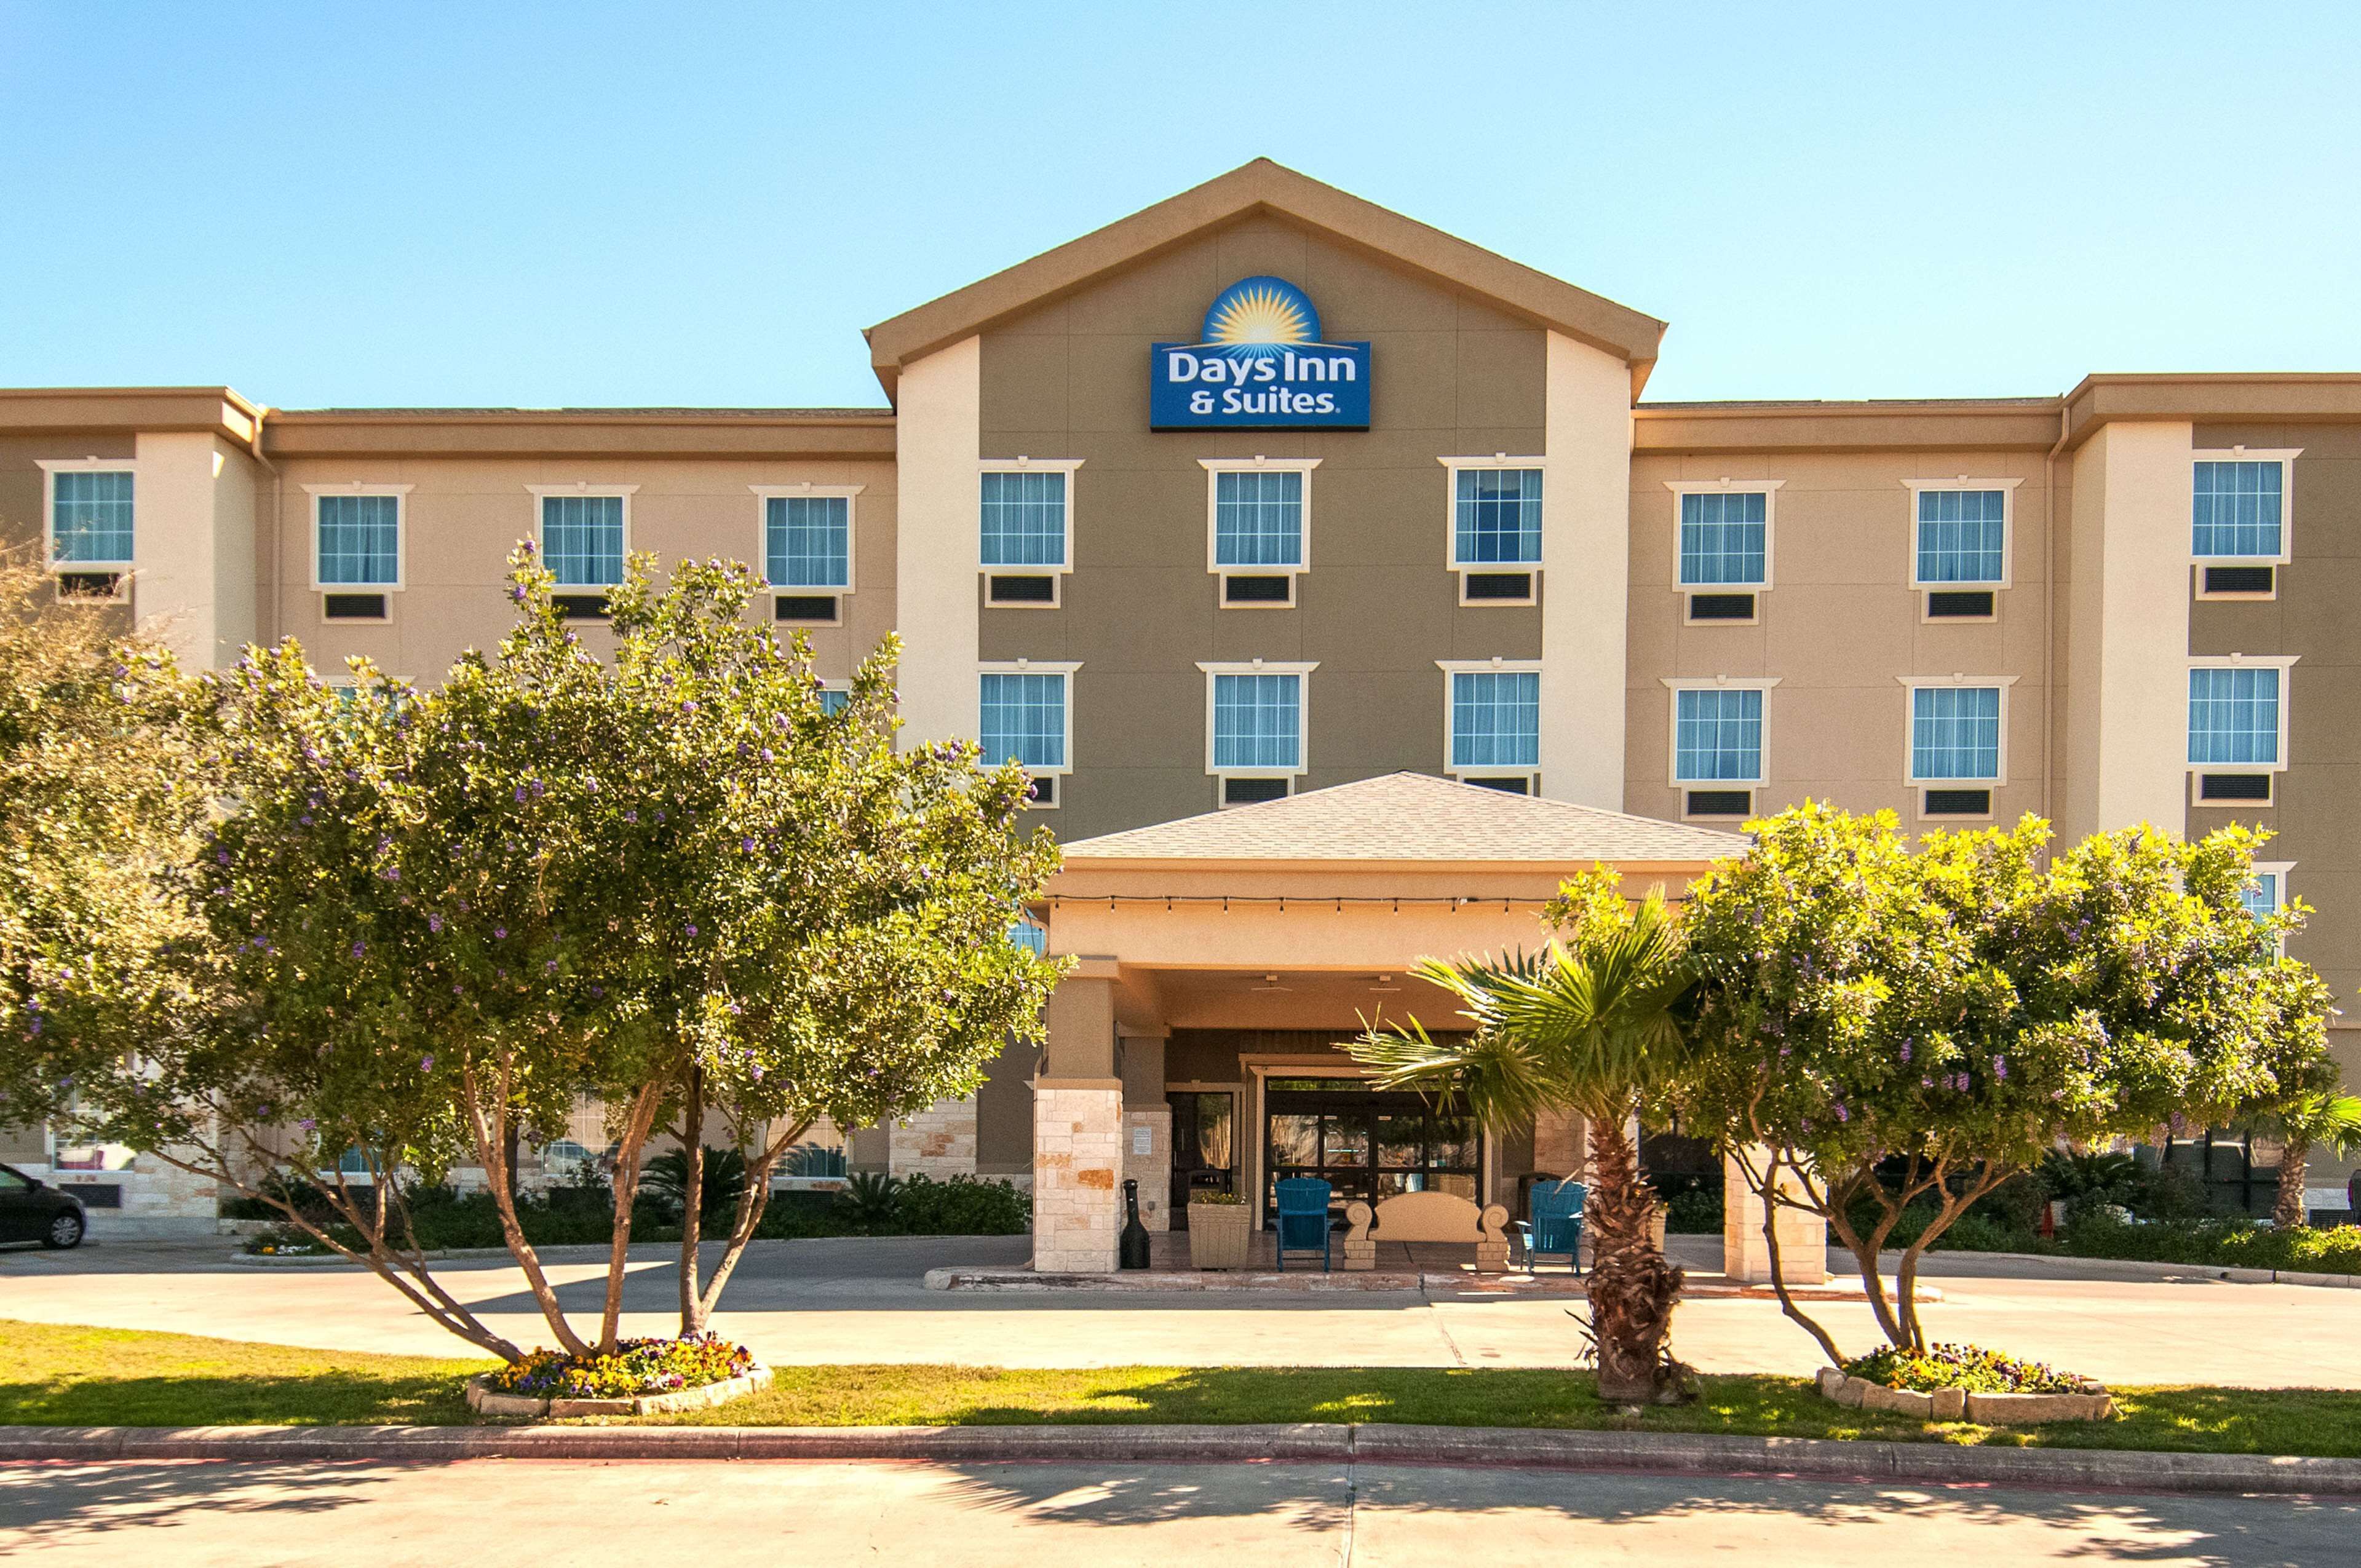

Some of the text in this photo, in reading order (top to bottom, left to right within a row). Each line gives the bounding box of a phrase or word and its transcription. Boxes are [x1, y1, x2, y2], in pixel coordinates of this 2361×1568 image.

[1169, 352, 1355, 386] Days Inn
[1189, 386, 1335, 414] & Suites
